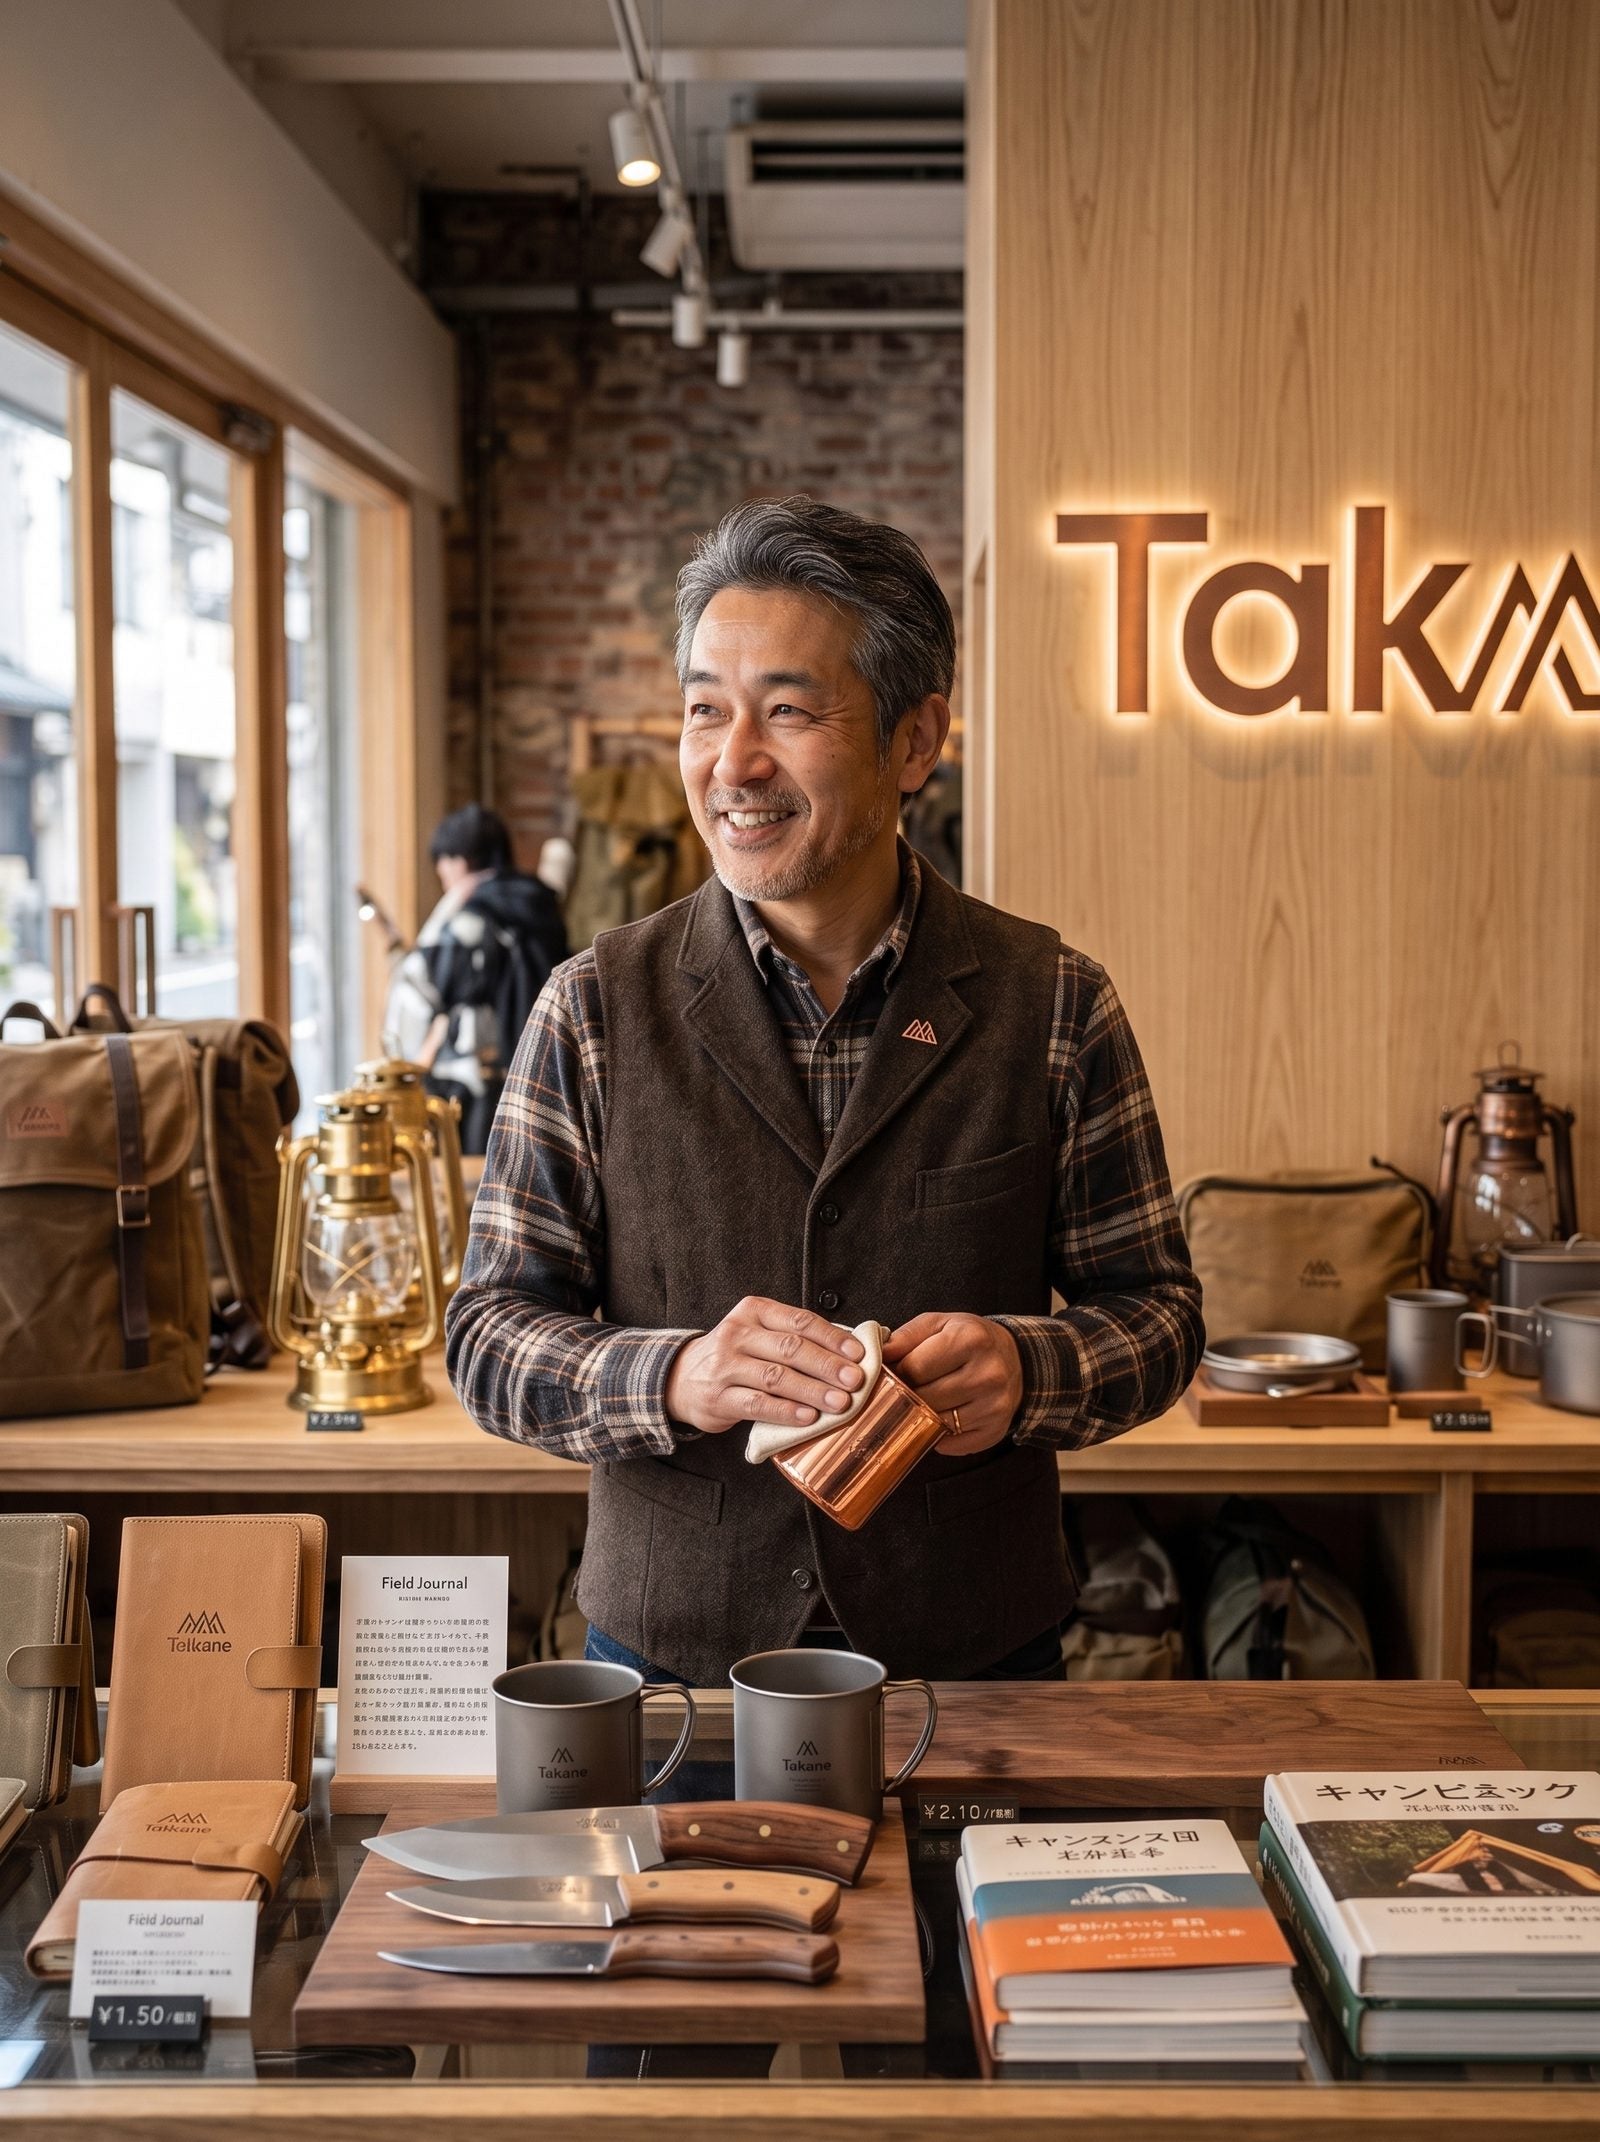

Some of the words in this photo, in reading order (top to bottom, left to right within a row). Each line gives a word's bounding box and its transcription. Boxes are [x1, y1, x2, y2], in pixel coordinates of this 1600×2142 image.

[382, 1577, 414, 1589] Field
[417, 1577, 468, 1590] Journal
[782, 1758, 832, 1772] Takane
[538, 1766, 588, 1779] Takane
[160, 1914, 204, 1926] Journal
